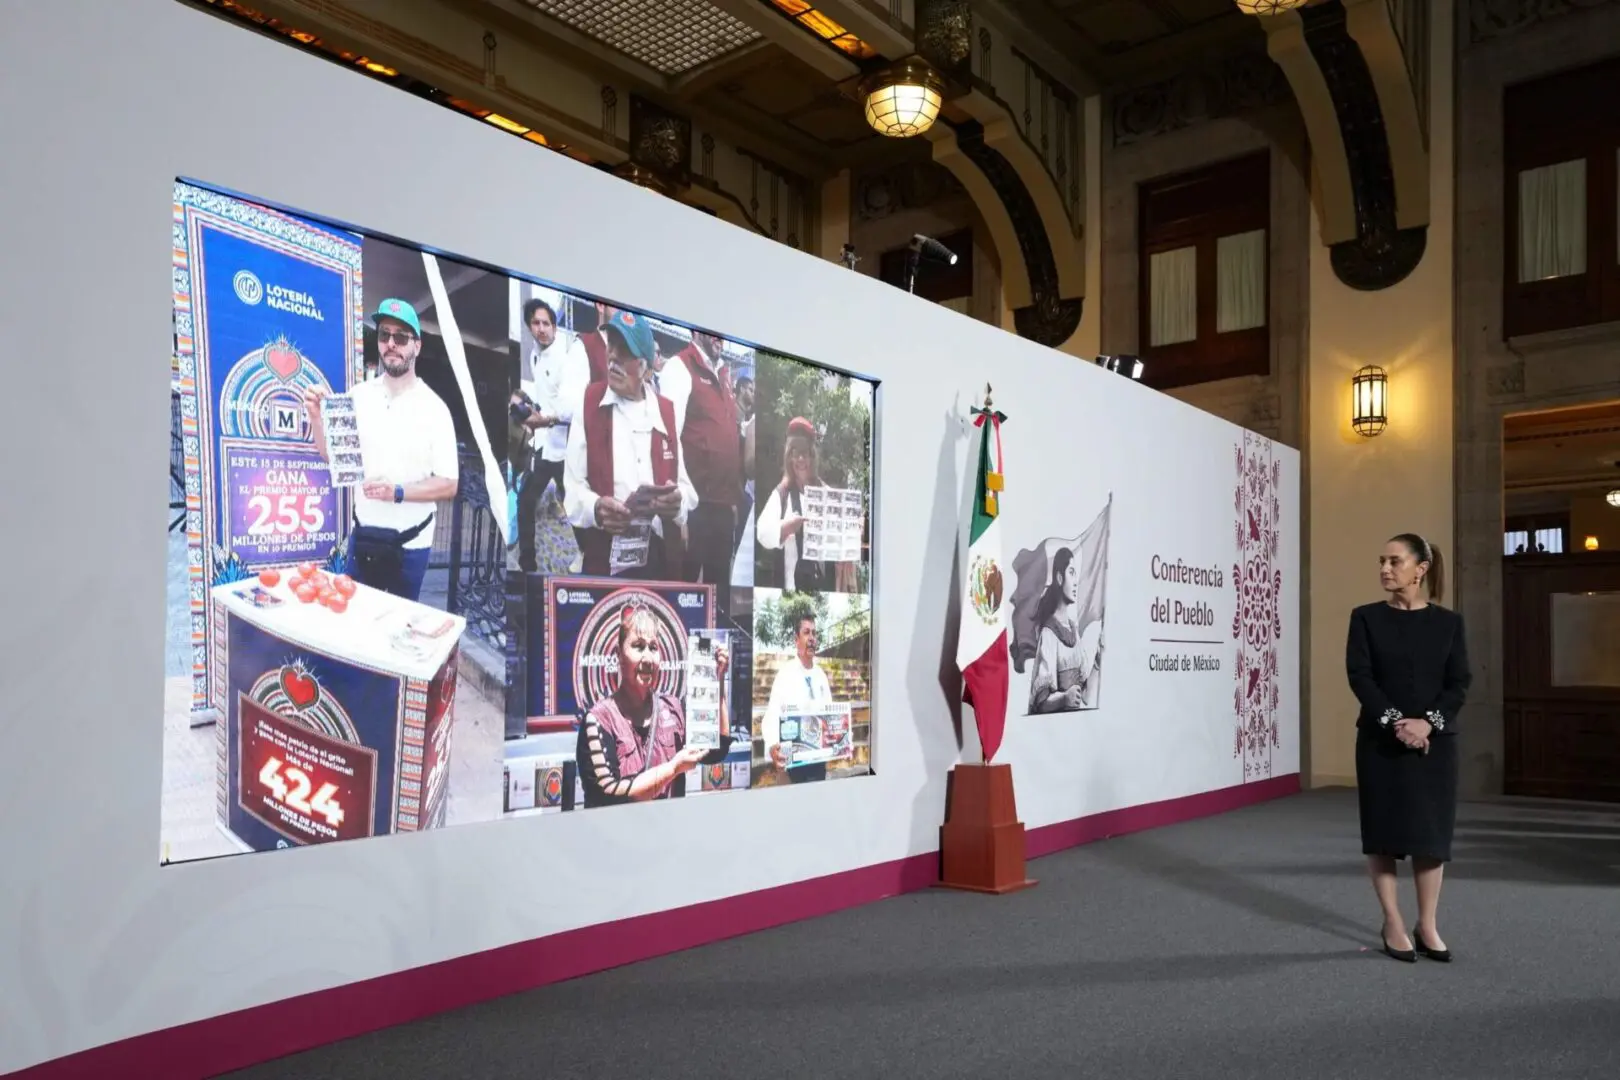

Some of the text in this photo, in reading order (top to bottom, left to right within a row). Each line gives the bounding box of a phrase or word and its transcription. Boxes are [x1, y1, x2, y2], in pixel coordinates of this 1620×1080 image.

[266, 283, 315, 307] LOTERÍA
[267, 296, 325, 322] NACIONAL
[278, 410, 294, 428] M
[231, 456, 258, 468] ESTE
[273, 459, 285, 469] DE
[287, 460, 330, 470] SEPTIEMBR
[265, 470, 308, 485] GANA
[239, 485, 330, 496] EL PREMIO MAYOR DE
[247, 495, 325, 536] 255
[232, 531, 336, 547] MILLONES DE PESOS
[257, 544, 269, 553] EN
[282, 542, 317, 553] PREMIOS
[1151, 554, 1223, 588] Conferencia
[1150, 596, 1214, 626] del Pueblo
[1149, 653, 1220, 672] Ciudad de México
[259, 755, 345, 829] 424
[263, 795, 338, 838] MILLONES DE PESOS
